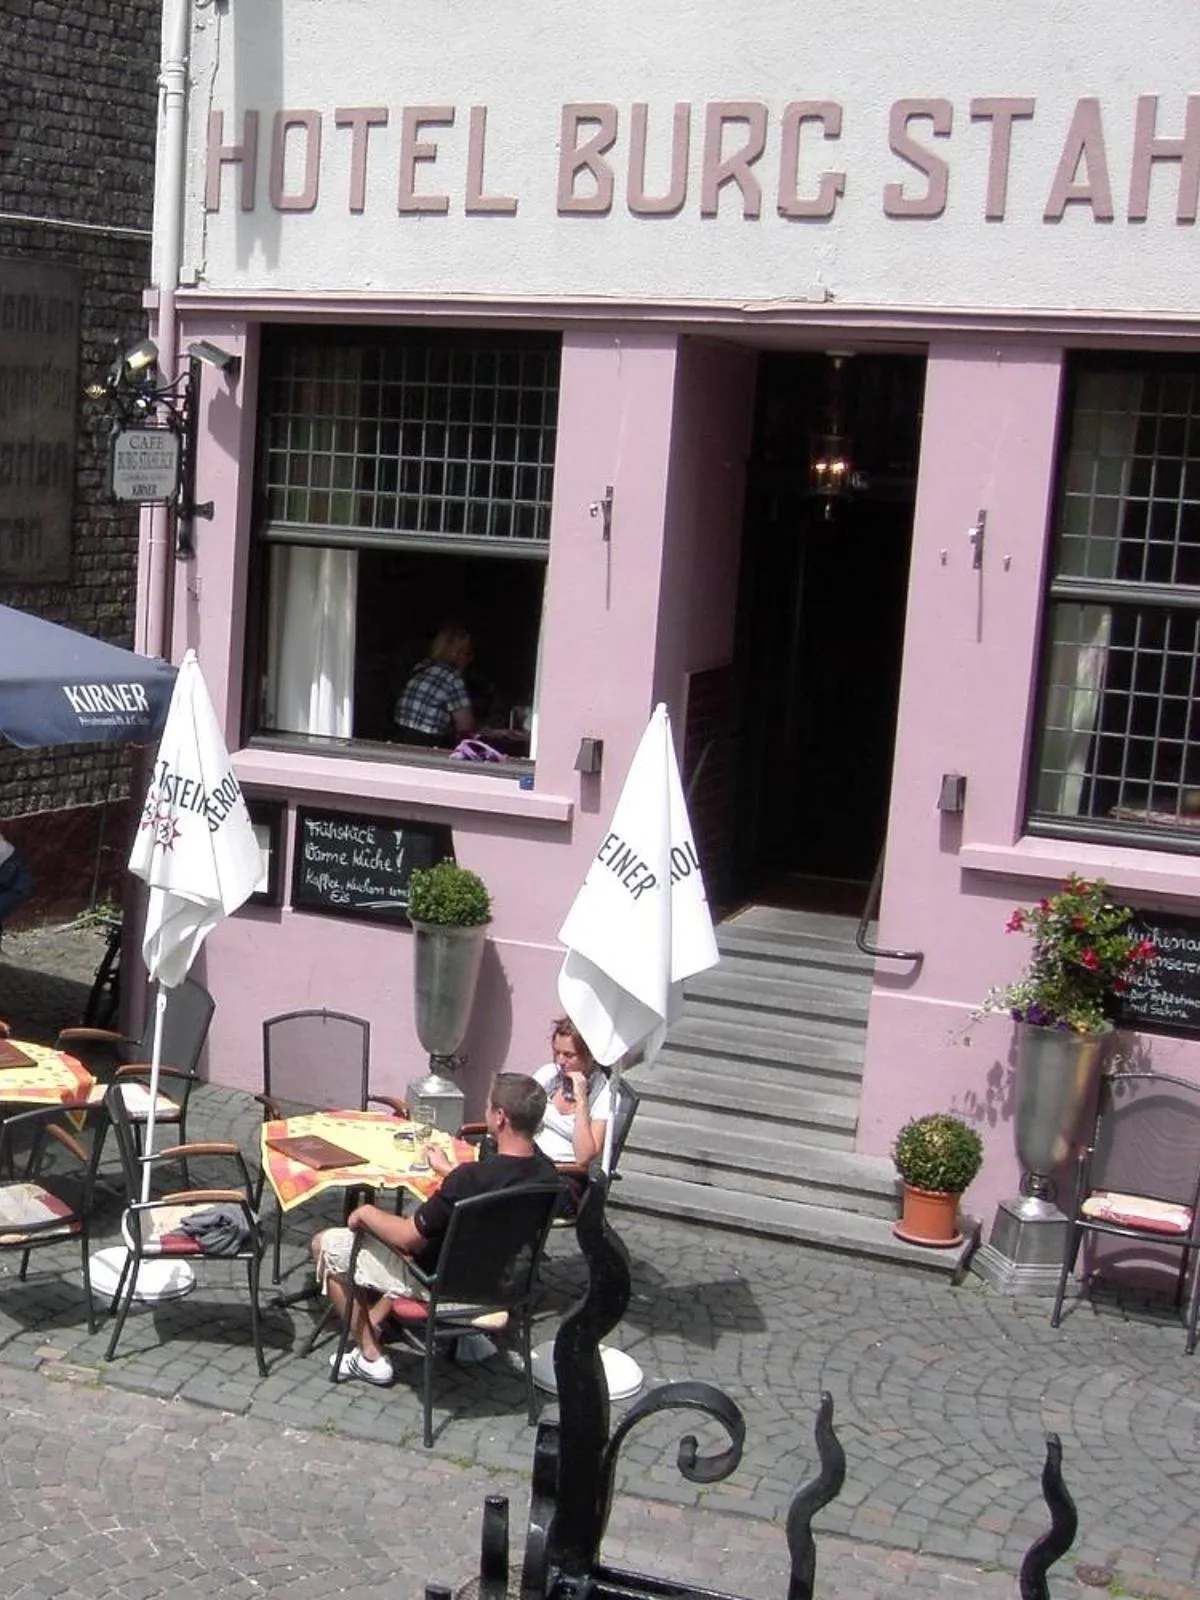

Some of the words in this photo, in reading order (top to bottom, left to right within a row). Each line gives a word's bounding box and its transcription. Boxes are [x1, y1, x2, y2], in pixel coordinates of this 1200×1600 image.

[205, 105, 519, 217] HOTEL
[556, 100, 847, 222] BURG
[882, 94, 1200, 226] STAH
[62, 683, 150, 713] KIRNER
